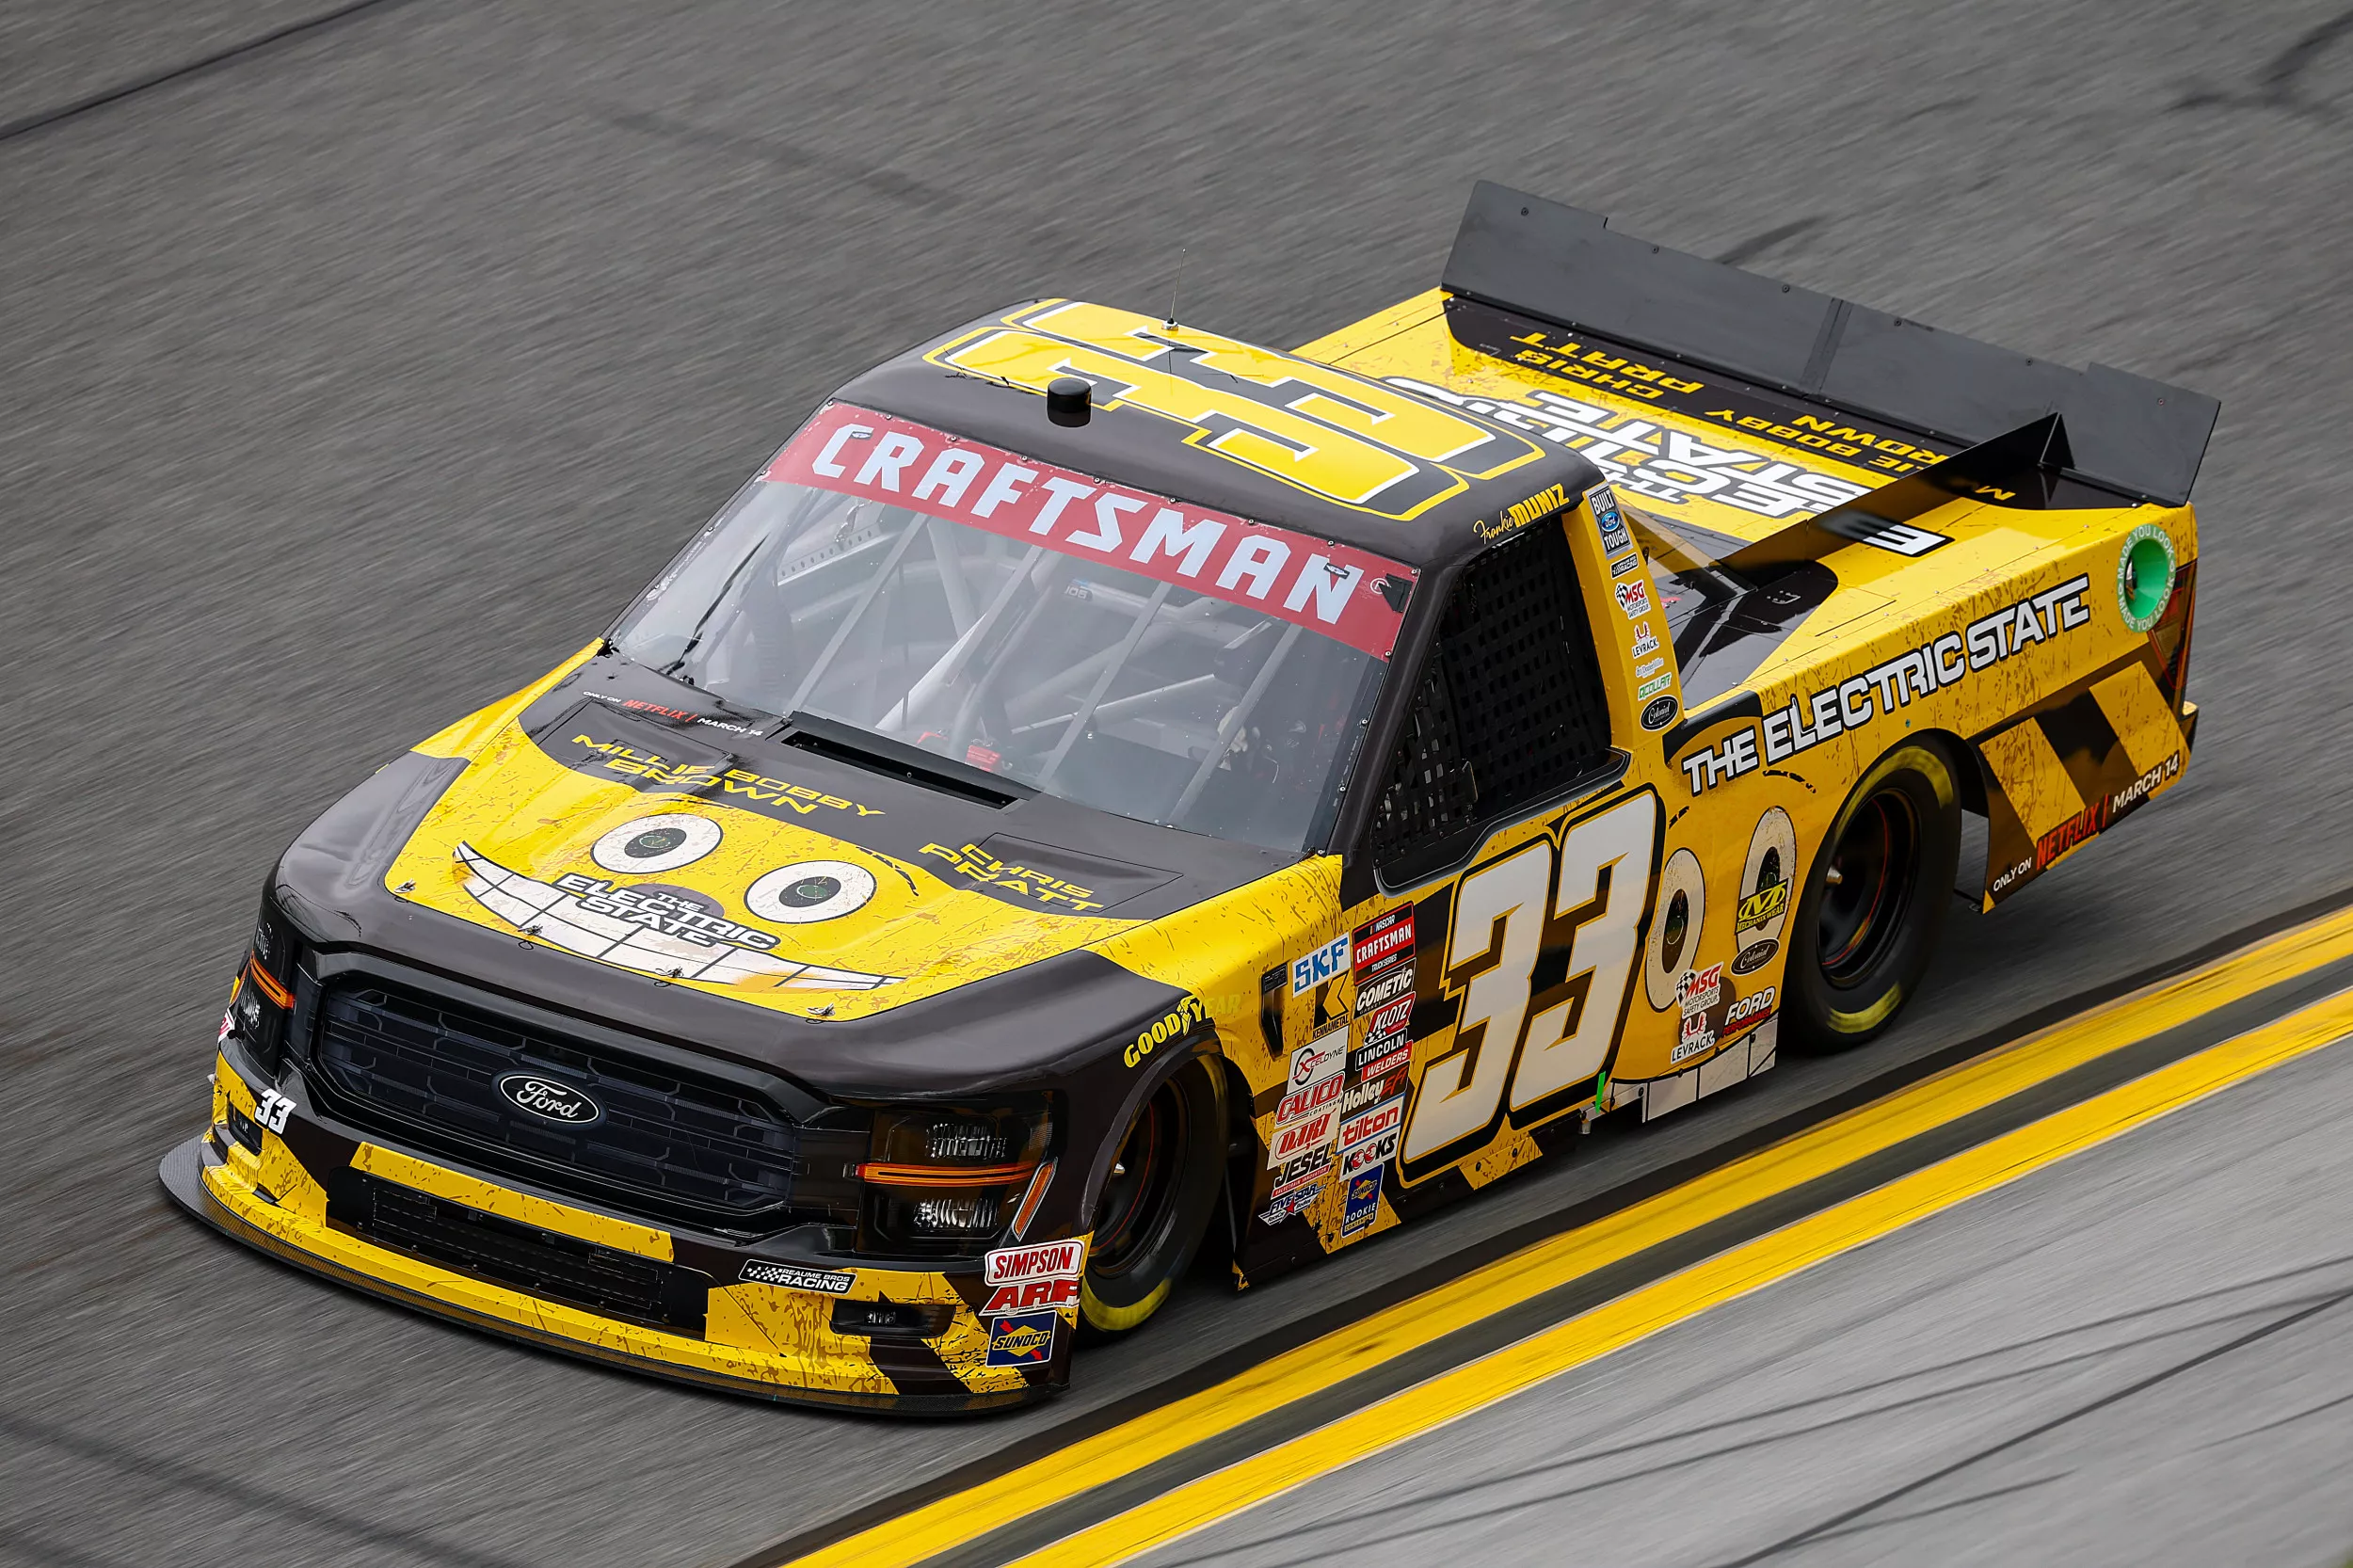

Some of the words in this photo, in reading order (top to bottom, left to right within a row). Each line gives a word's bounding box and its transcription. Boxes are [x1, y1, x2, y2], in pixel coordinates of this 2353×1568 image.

[1510, 332, 1705, 393] PRATT
[1513, 349, 1664, 399] CHRIS
[932, 298, 1529, 514] 33
[1705, 409, 1863, 456] BOBBY
[1792, 414, 1949, 464] ROWN
[1473, 511, 1514, 544] Frankie
[1508, 484, 1569, 528] MUNIZ
[1592, 489, 1615, 515] BUILT
[811, 423, 1365, 625] CRAFTSMAN
[1604, 528, 1628, 551] TOUGH
[2118, 537, 2135, 579] MADE
[2133, 524, 2152, 540] YOU
[2153, 527, 2175, 558] LOOK
[1625, 582, 1645, 603] MSG
[2118, 599, 2136, 630] MADE
[2137, 616, 2153, 632] YOU
[2153, 577, 2175, 619] LOOK
[1682, 728, 1758, 796] THE
[1763, 636, 1965, 765] ELECTRIC
[1967, 575, 2089, 671] STATE
[583, 691, 607, 702] ONLY
[621, 698, 689, 721] NETFLIX
[696, 717, 748, 734] MARCH
[571, 734, 715, 776] MILLIE
[724, 768, 886, 817] BOBBY
[603, 759, 819, 815] BROWN
[1993, 866, 2018, 892] ONLY
[2017, 857, 2032, 875] ON
[2036, 803, 2100, 871] NETFLIX
[2112, 767, 2163, 813] MARCH
[2165, 753, 2179, 776] 14
[960, 843, 1095, 898] CHRIS
[554, 873, 780, 949] ELECTRIC
[579, 895, 715, 947] STATE
[658, 892, 707, 911] THE
[1737, 914, 1767, 933] MECHANIX
[1766, 904, 1785, 919] WEAR
[1356, 923, 1412, 964] CRAFTSMAN
[1375, 915, 1396, 932] NASCAR
[1294, 937, 1348, 993] SKF
[1402, 789, 1659, 1163] 33
[1686, 964, 1722, 998] MSG
[1356, 968, 1413, 1012] COMETIC
[1683, 1004, 1700, 1016] SAFETY
[1685, 986, 1720, 1007] MOTORSPORTS
[1724, 986, 1775, 1026] FORD
[1312, 1015, 1350, 1040] KENNAMETAL
[1372, 999, 1412, 1032] KLOTZ
[1358, 1033, 1404, 1066] LINCOLN
[1367, 1048, 1409, 1077] WELDERS
[254, 1088, 297, 1135] 33
[516, 1080, 582, 1118] Ford
[1277, 1074, 1344, 1123] CALICO
[1342, 1080, 1385, 1114] Holley
[1342, 1106, 1400, 1146] tilton
[1274, 1143, 1333, 1189] JESEL
[1342, 1132, 1398, 1176] KOOKS
[1270, 1196, 1293, 1215] FIVE
[1295, 1183, 1319, 1200] STAR
[1345, 1202, 1376, 1224] ROOKIE
[777, 1274, 849, 1291] RACING
[781, 1269, 823, 1279] REAUME
[823, 1273, 851, 1282] BROS
[994, 1247, 1074, 1279] SIMPSON
[984, 1279, 1079, 1311] ARP
[993, 1332, 1050, 1350] SUNOCO
